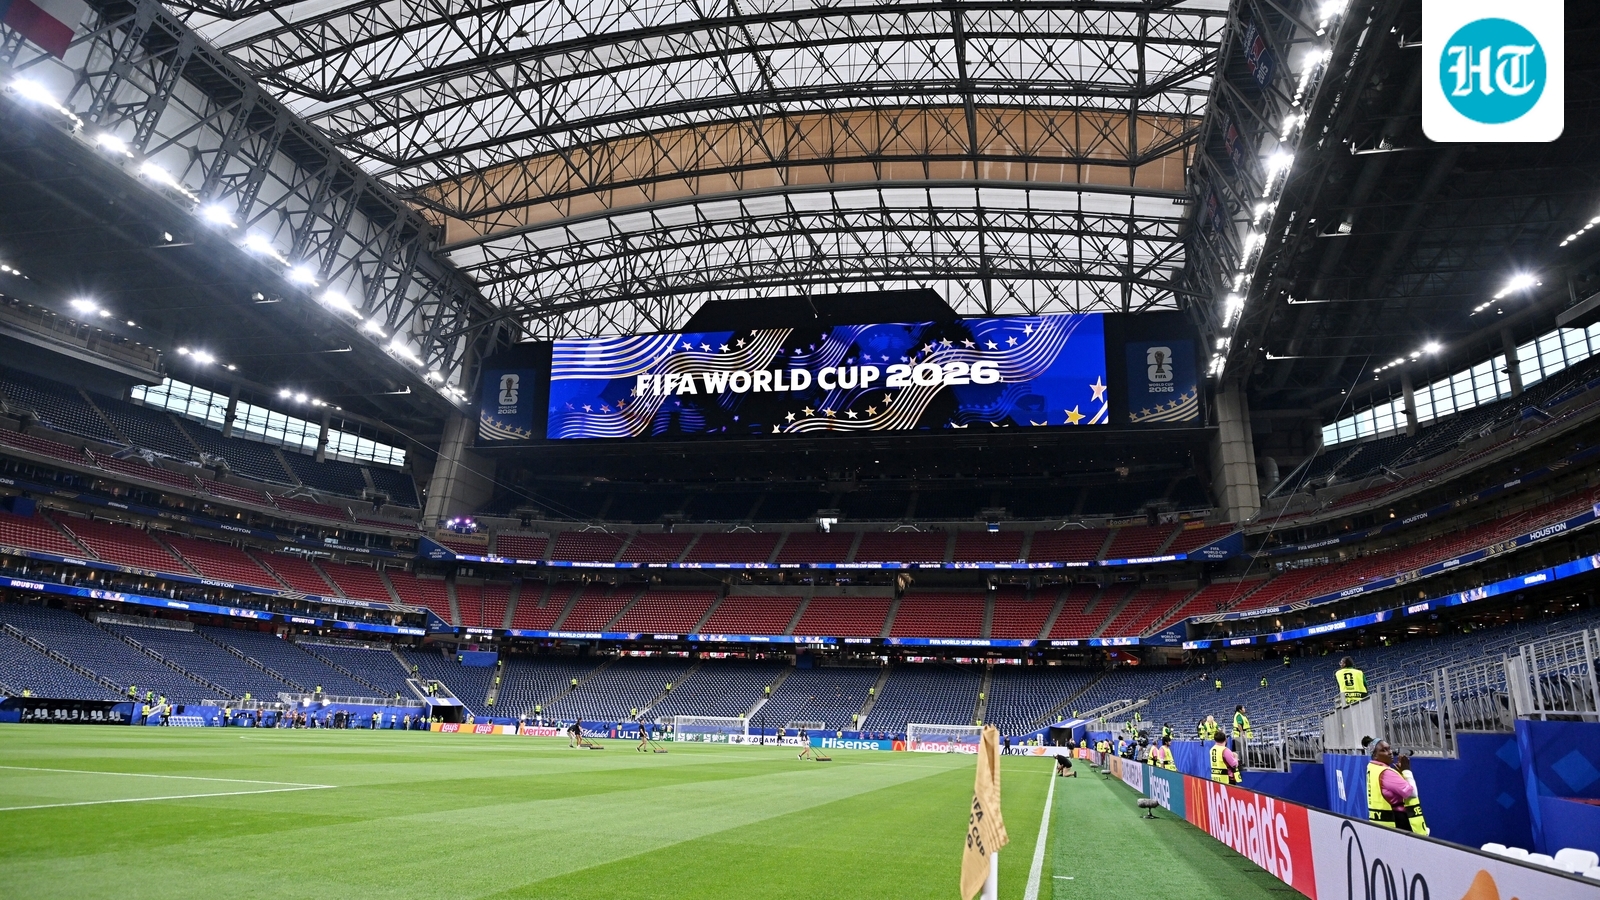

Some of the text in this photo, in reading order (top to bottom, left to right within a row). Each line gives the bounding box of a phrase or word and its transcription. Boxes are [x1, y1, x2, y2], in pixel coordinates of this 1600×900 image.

[636, 360, 1000, 397] FIFA WORLD CUP 2026
[1402, 512, 1428, 525] HOUSTON
[220, 524, 251, 534] HOUSTON
[1530, 522, 1567, 540] HOUSTON
[11, 580, 44, 590] HOUSTON
[201, 580, 234, 588] HOUSTON
[1341, 587, 1364, 597] HOUSTON
[1408, 603, 1429, 614] HOUSTON
[524, 727, 556, 736] verizon
[822, 738, 878, 750] Hisense
[1002, 745, 1028, 756] ove
[1149, 766, 1170, 810] Hisense
[972, 797, 984, 823] IFA
[1206, 780, 1292, 886] McDonald's
[972, 826, 985, 856] CUP
